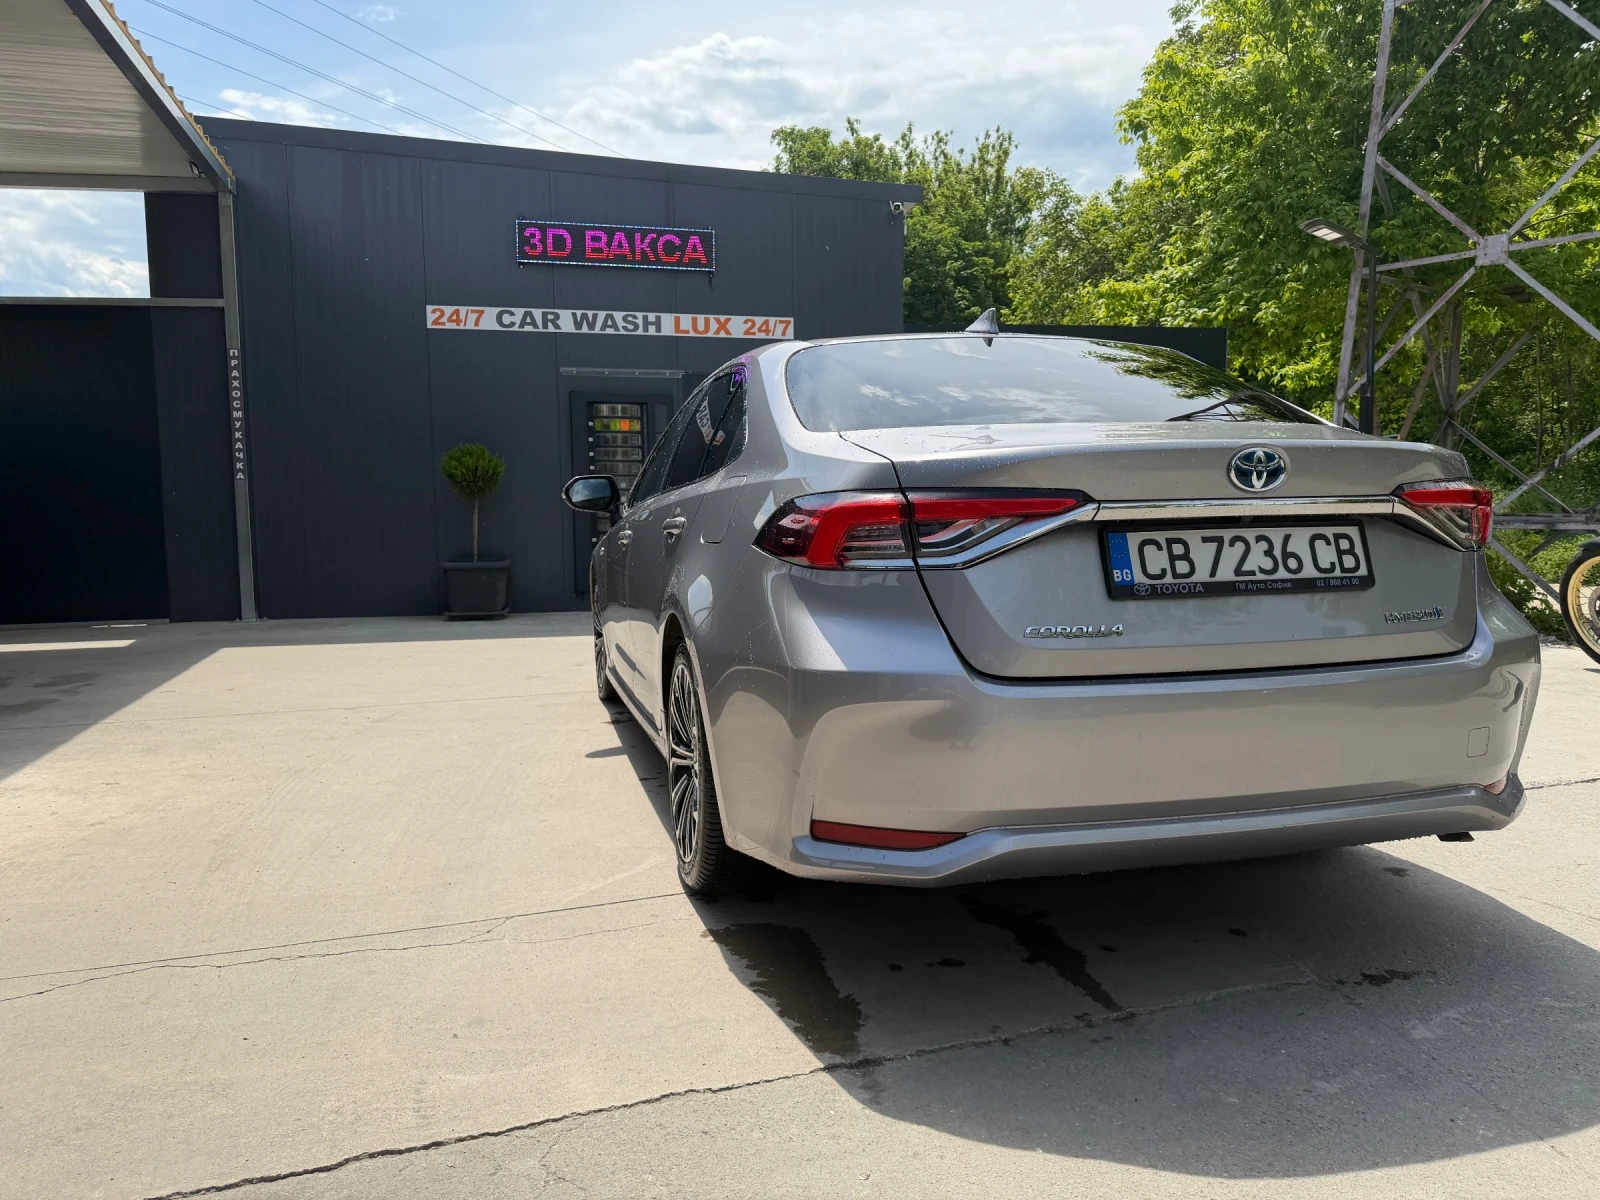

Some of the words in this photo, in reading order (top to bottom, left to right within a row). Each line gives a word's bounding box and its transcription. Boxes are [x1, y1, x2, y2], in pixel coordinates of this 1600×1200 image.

[523, 227, 572, 257] 3D
[430, 307, 486, 328] 24/7
[495, 309, 562, 331] CAR
[571, 311, 662, 334] WASH
[673, 315, 733, 336] LUX
[743, 318, 792, 337] 24/7
[229, 349, 245, 479] ПРАХОСМУКАЧКА
[1137, 537, 1197, 581] CB
[1201, 534, 1304, 579] 7236
[1308, 532, 1362, 575] CB
[1113, 569, 1132, 582] BG
[1266, 580, 1292, 590] София
[1155, 583, 1205, 595] TOYOTA
[1024, 623, 1124, 640] COROLLA
